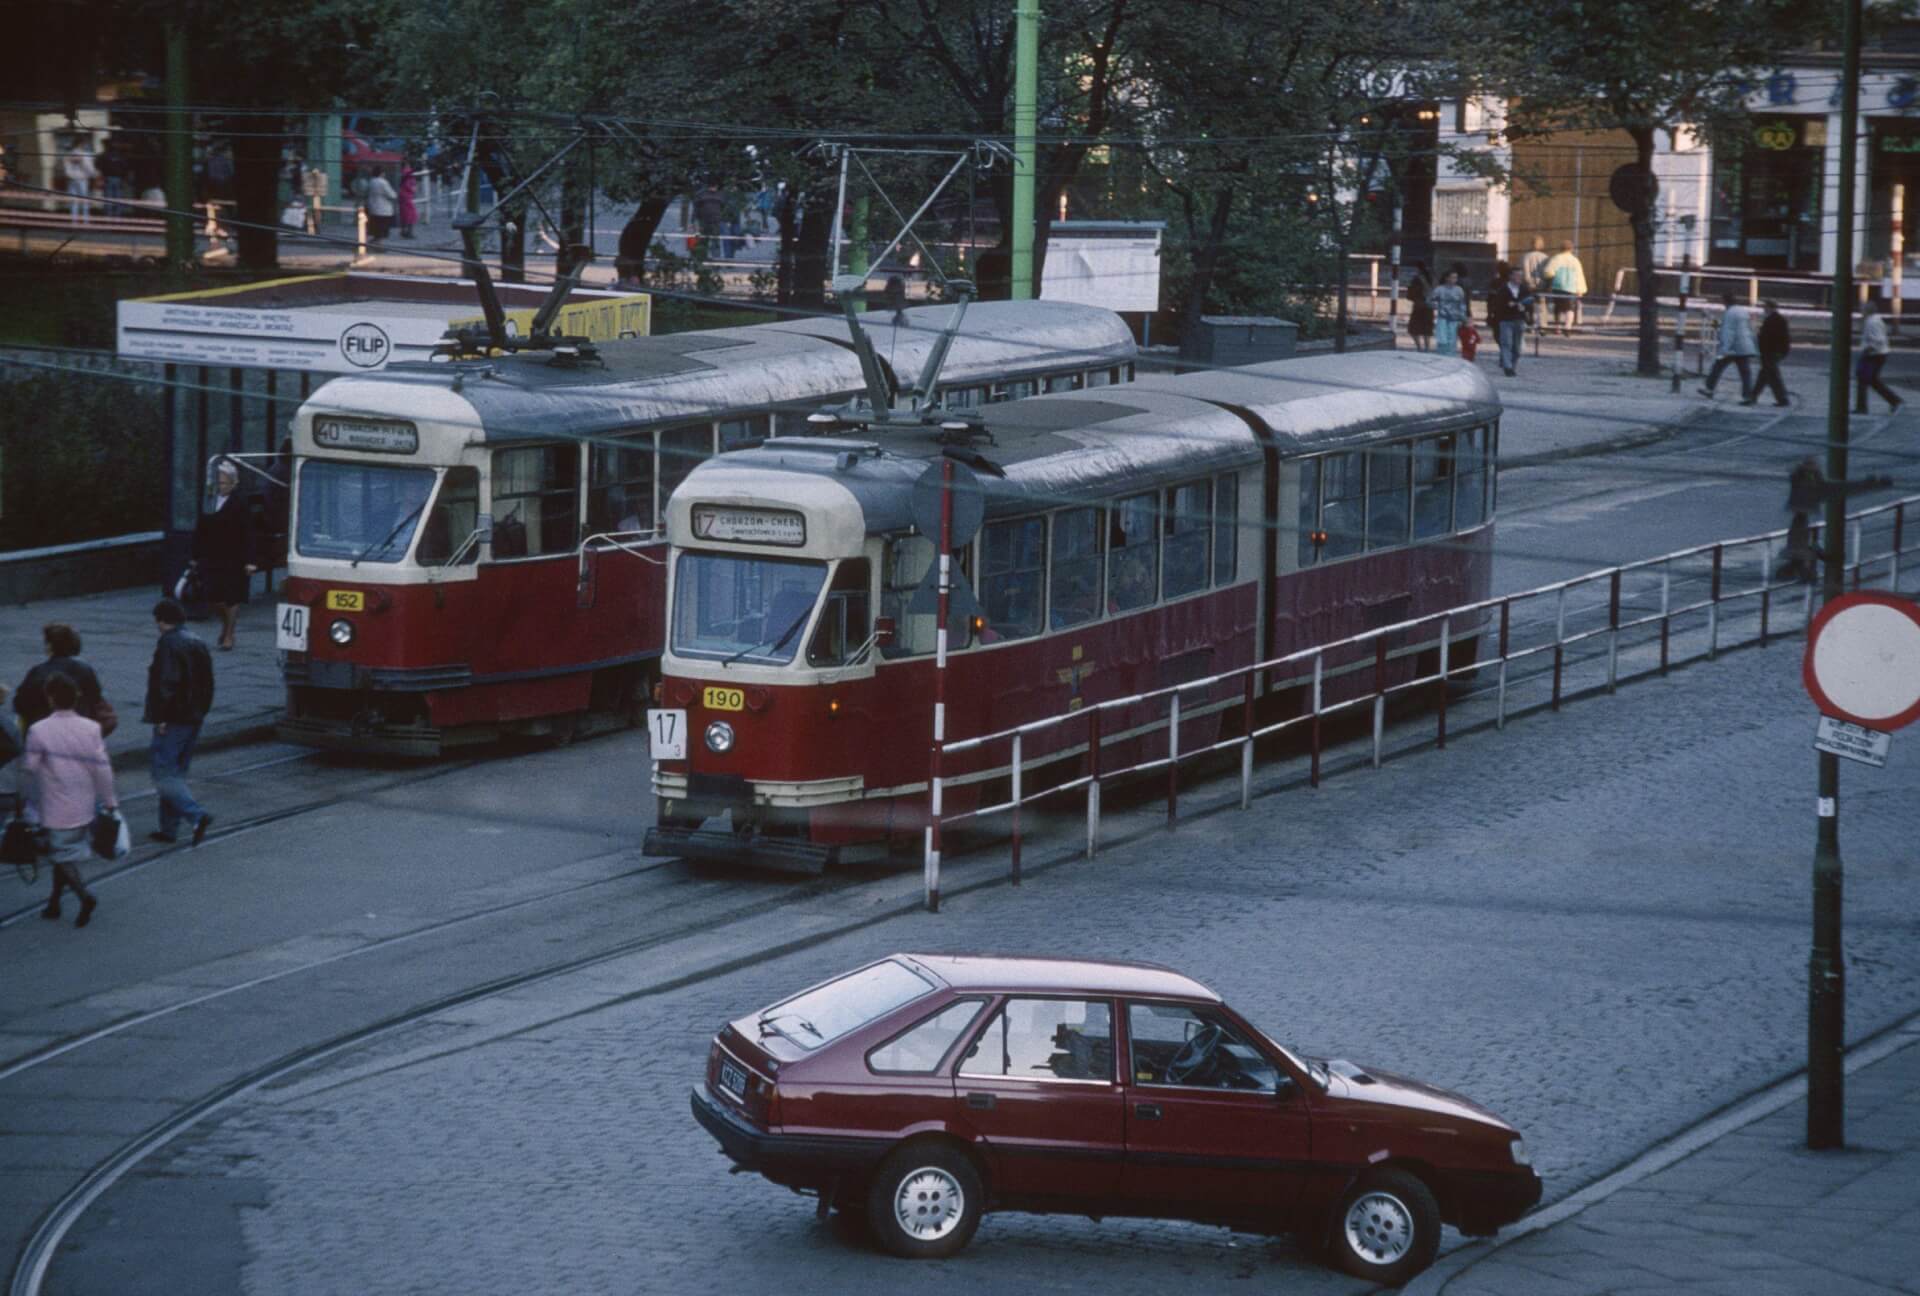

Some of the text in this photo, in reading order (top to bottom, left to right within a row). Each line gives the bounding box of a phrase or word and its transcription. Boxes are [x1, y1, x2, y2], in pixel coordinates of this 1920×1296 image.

[346, 336, 384, 354] FILIP
[319, 421, 340, 441] 40
[695, 512, 716, 535] 17
[335, 592, 357, 608] 152
[282, 607, 303, 637] 40
[706, 689, 741, 708] 190
[656, 712, 677, 745] 17
